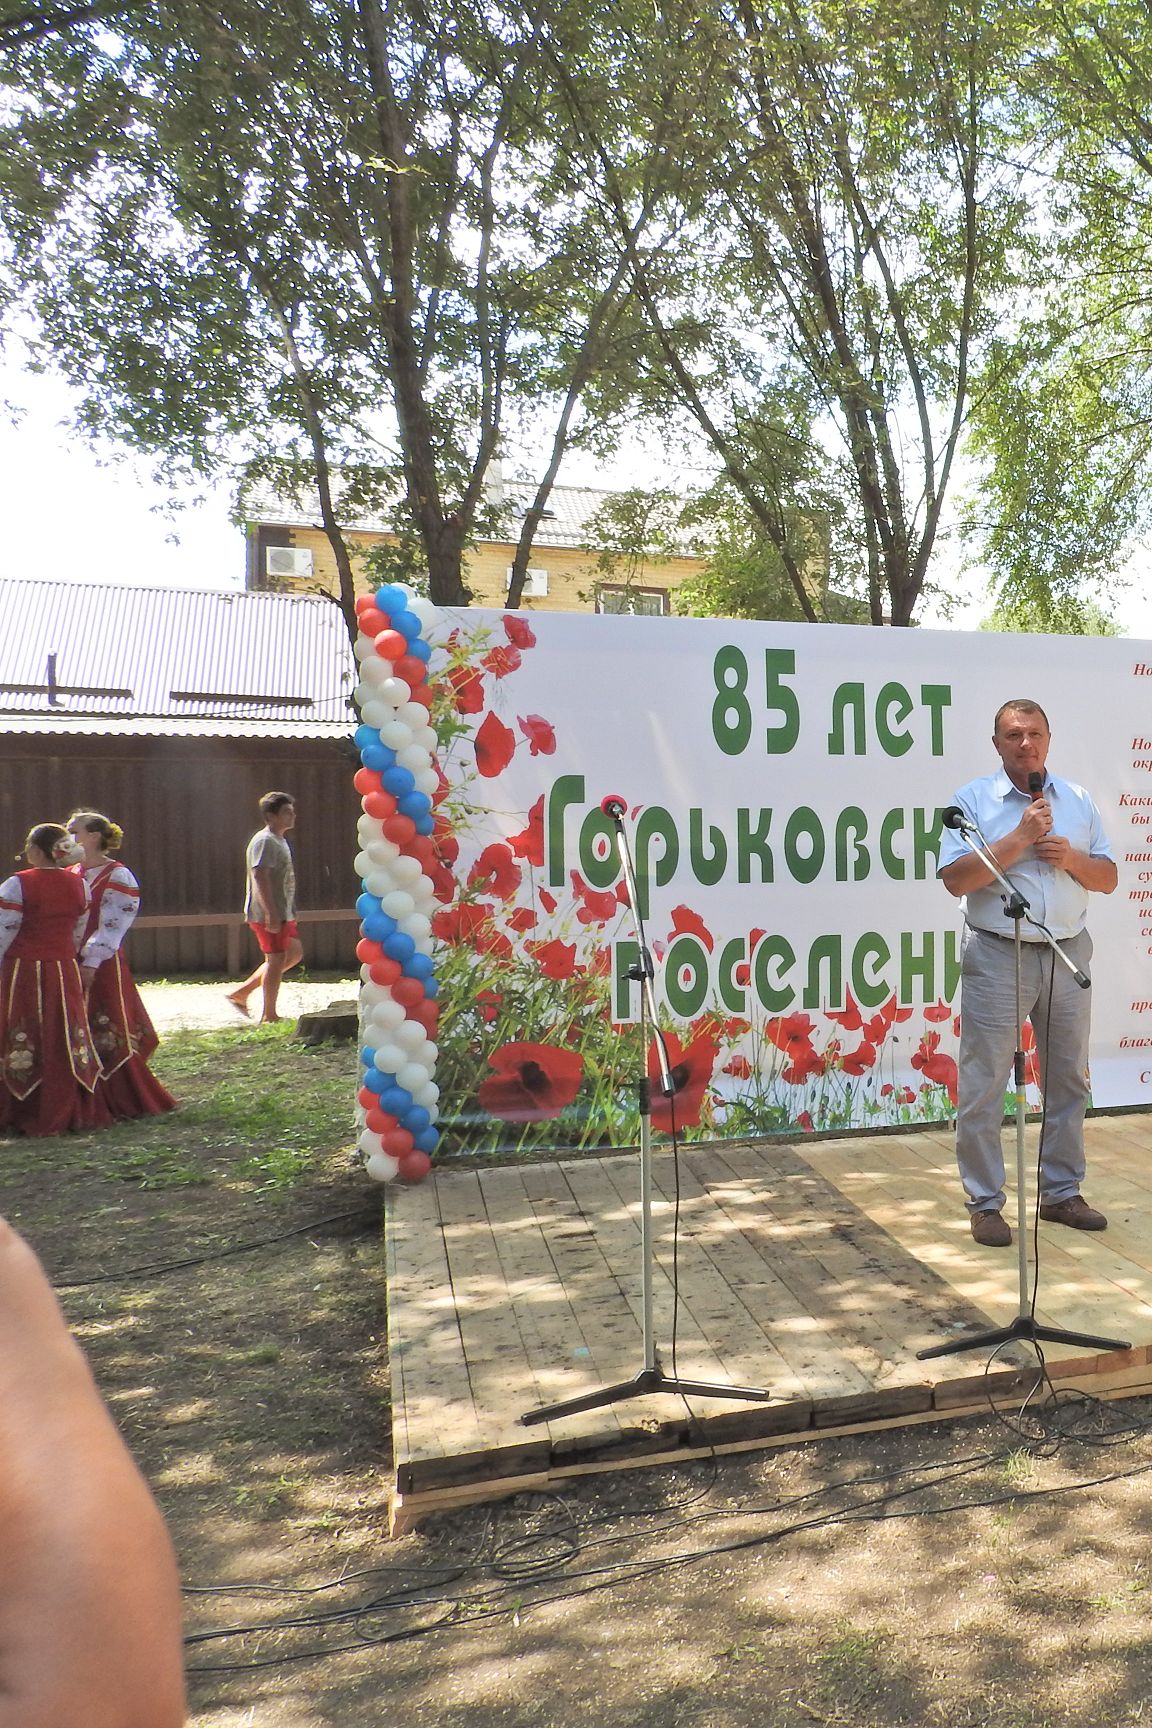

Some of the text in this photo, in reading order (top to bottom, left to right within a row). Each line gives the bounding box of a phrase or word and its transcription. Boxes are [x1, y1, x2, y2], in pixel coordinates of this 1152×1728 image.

[711, 644, 952, 758] 85 лет
[548, 775, 946, 919] Горьковск
[616, 930, 962, 1019] поселени
